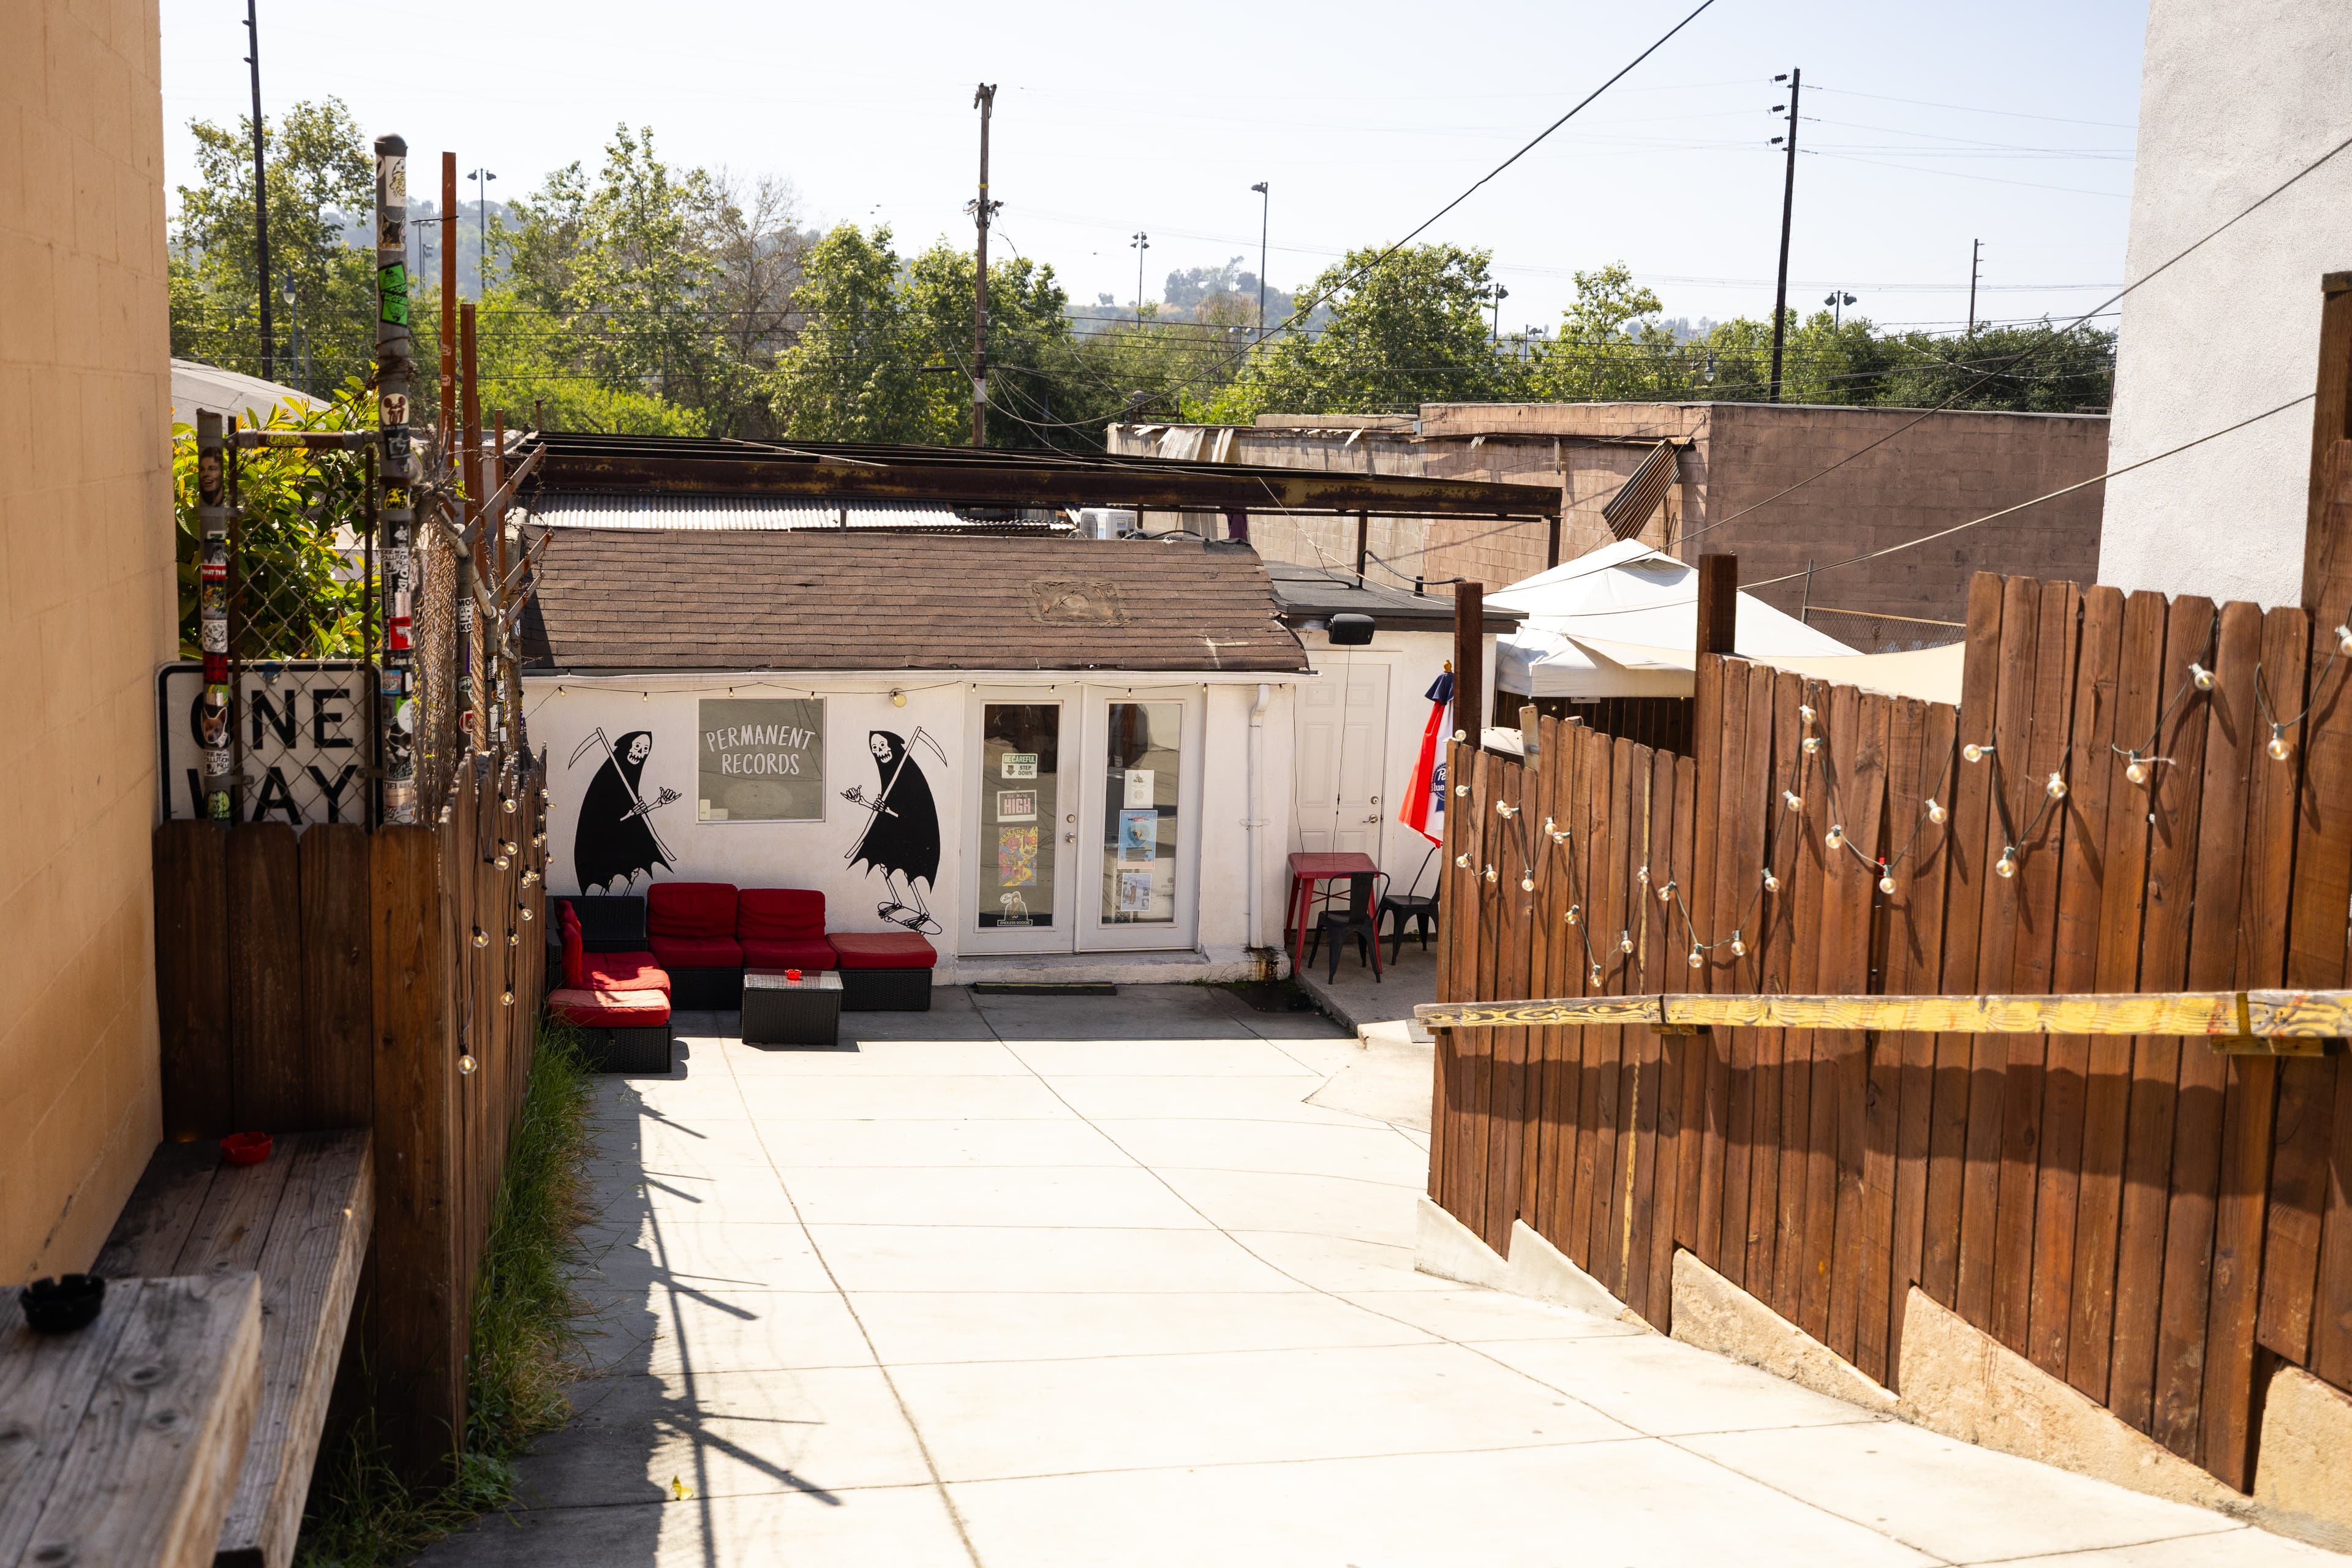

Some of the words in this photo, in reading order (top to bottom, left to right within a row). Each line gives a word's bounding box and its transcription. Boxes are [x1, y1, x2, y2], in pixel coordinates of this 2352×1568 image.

[706, 724, 815, 752] PERMANENT
[722, 753, 799, 775] RECORDS
[186, 764, 360, 826] AY
[1004, 798, 1031, 815] HIGH
